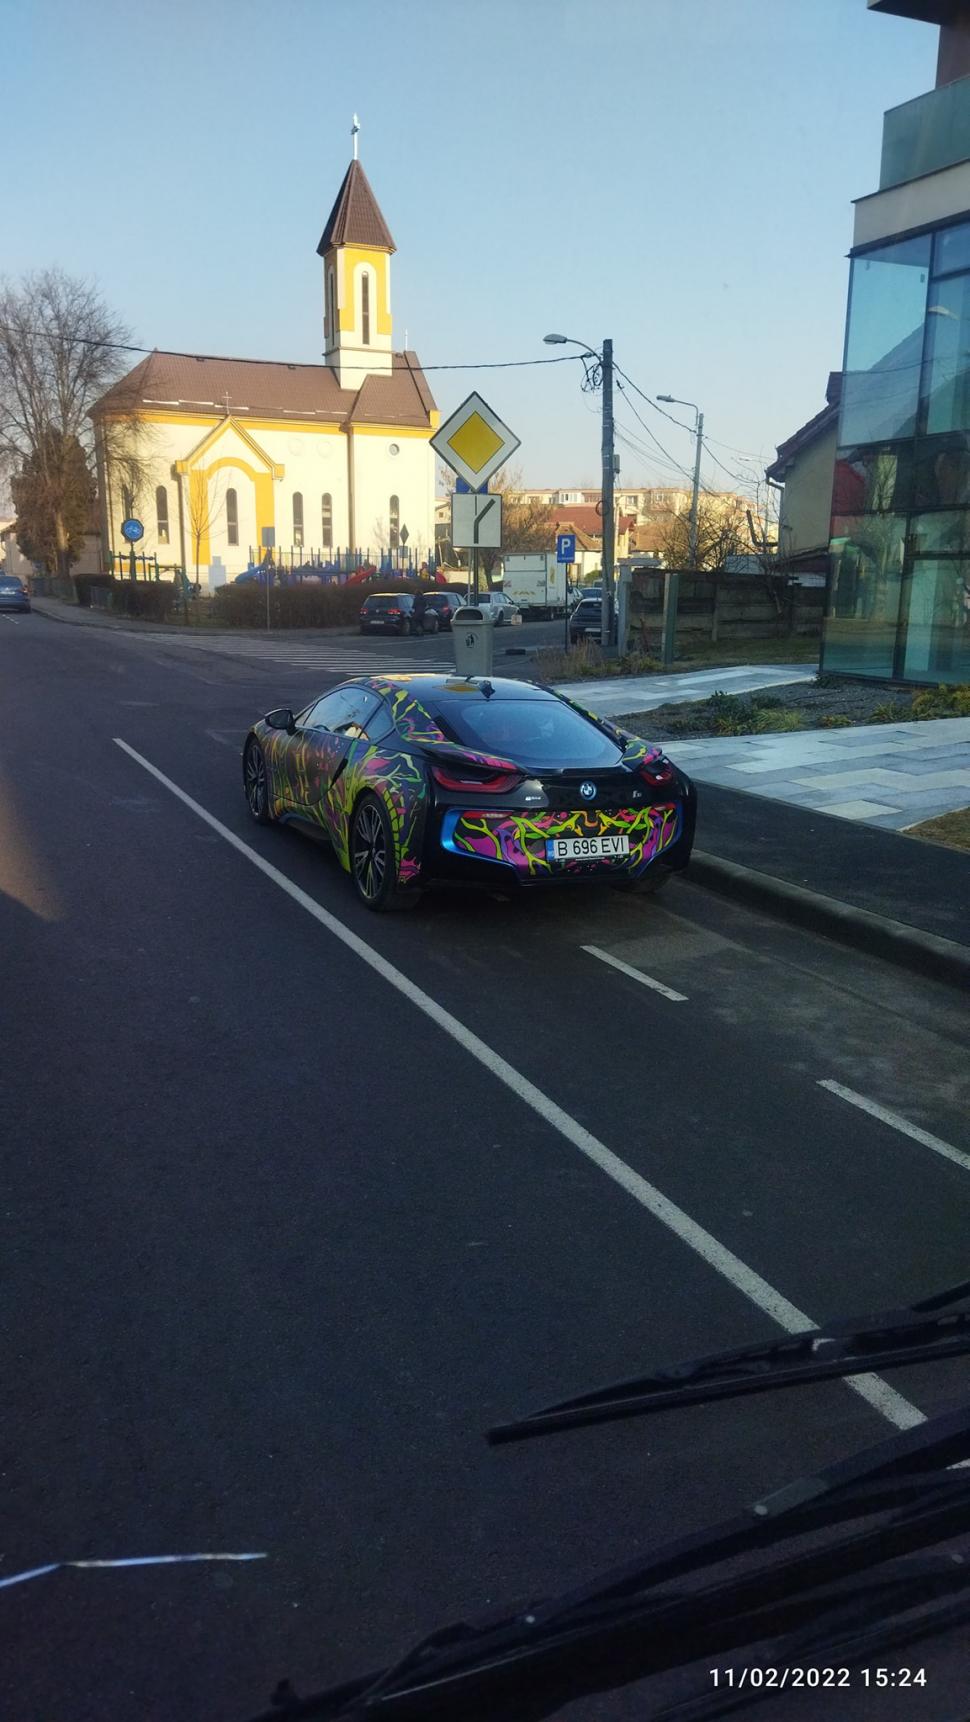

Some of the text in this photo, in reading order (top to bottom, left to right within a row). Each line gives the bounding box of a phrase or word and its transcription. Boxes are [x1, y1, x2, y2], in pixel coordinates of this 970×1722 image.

[561, 538, 571, 555] P
[557, 837, 624, 856] B 696 EVI
